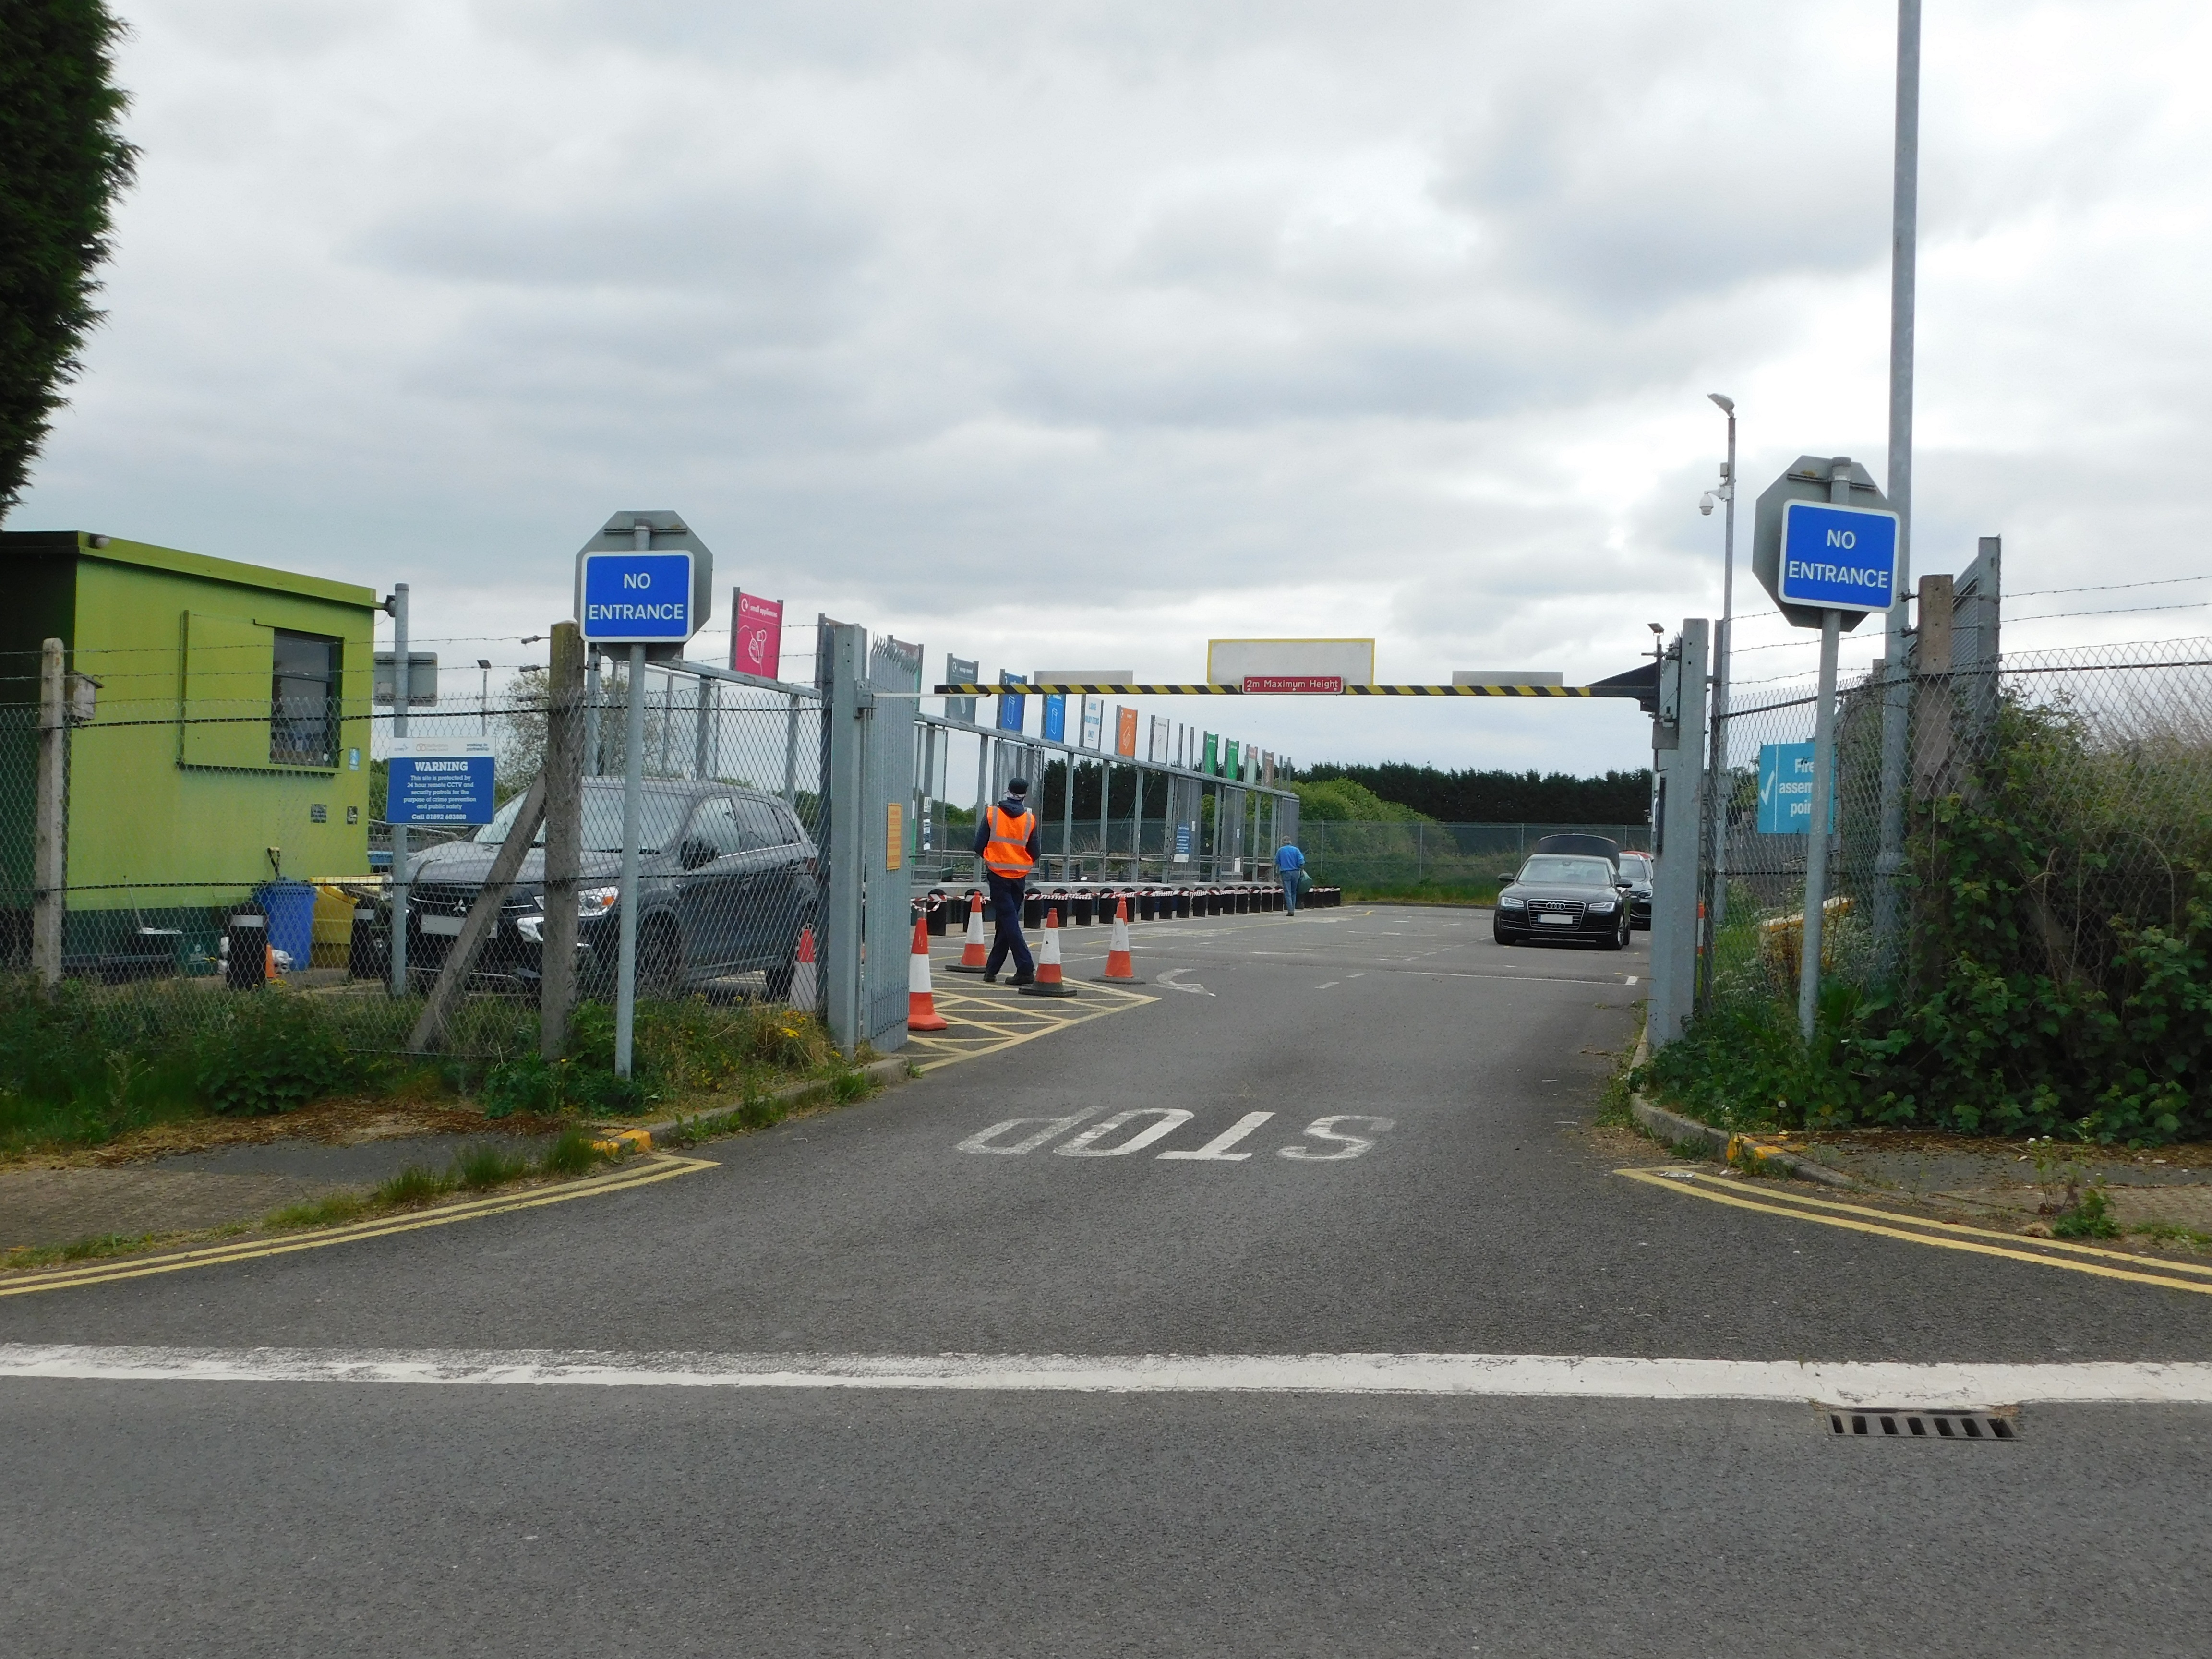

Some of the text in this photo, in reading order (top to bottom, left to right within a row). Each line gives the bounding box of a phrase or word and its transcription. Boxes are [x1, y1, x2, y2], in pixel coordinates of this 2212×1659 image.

[1827, 529, 1856, 549] NO
[624, 573, 651, 589] NO
[1789, 560, 1888, 588] ENTRANCE
[589, 604, 684, 620] ENTRANCE
[1310, 680, 1338, 689] Height
[415, 761, 468, 772] WARNING
[955, 1106, 1397, 1161] STOP
